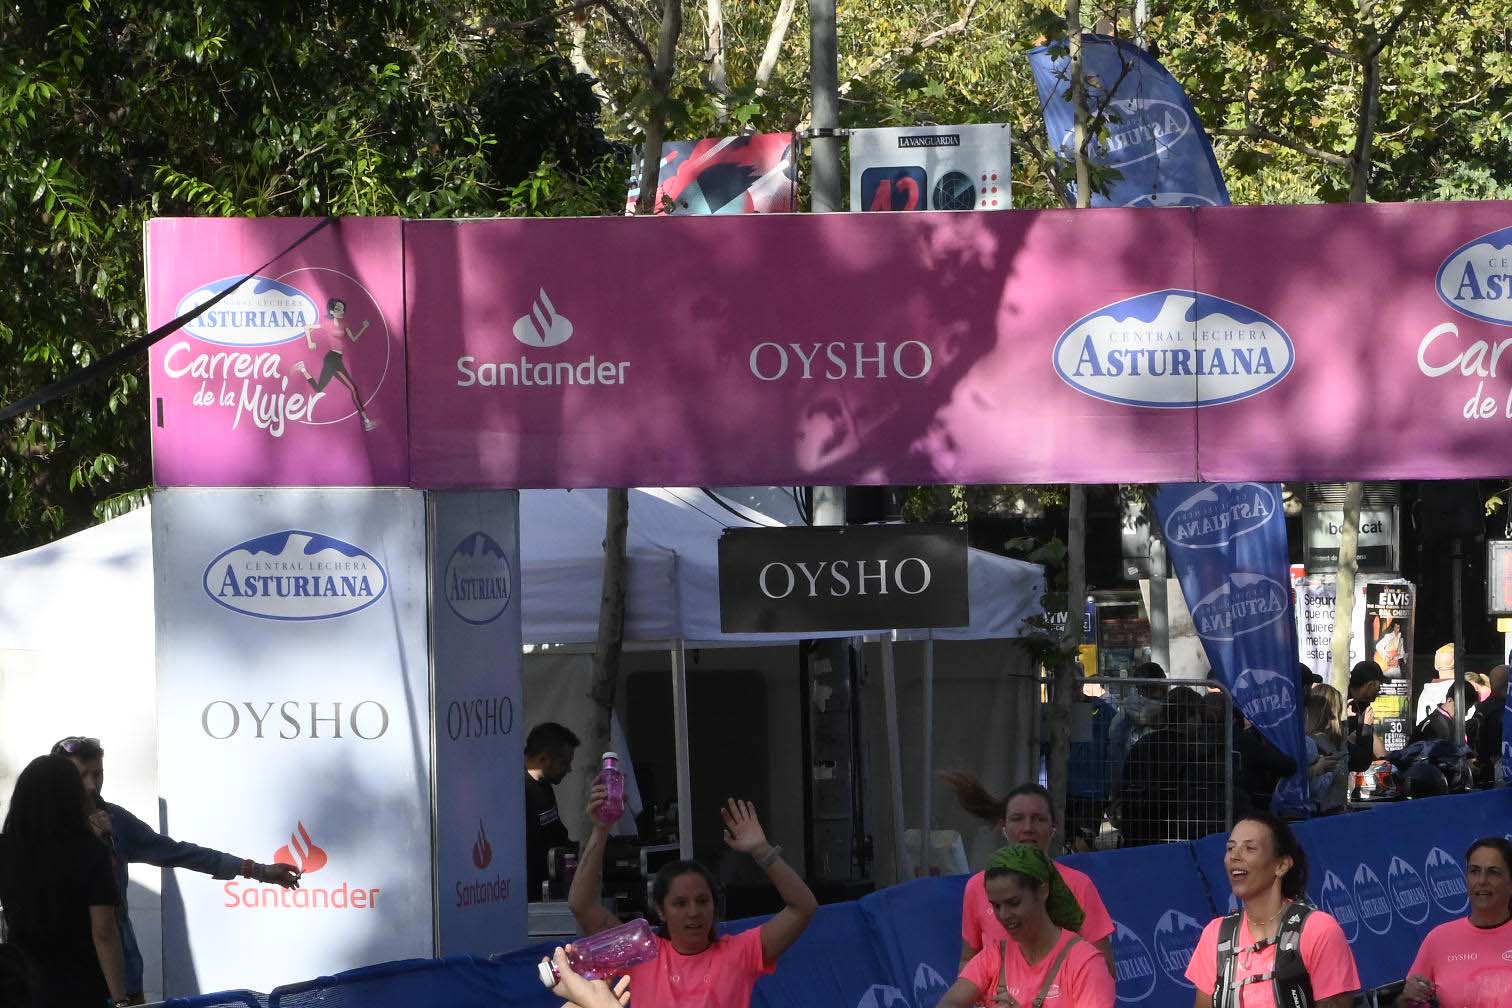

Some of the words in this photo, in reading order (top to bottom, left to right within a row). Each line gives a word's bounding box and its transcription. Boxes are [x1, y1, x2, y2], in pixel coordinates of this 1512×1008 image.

[1109, 329, 1184, 343] CENTRAL
[1192, 329, 1268, 342] LECHERA
[164, 341, 282, 379] Carrera
[457, 355, 631, 387] Santander
[749, 340, 934, 382] OYSHO
[1072, 335, 1276, 377] ASTURIANA
[192, 380, 215, 407] de
[219, 380, 236, 407] la
[232, 375, 327, 437] Mujer
[1463, 382, 1497, 419] de
[218, 564, 374, 598] ASTURIANA
[245, 561, 302, 571] CENTRAL
[308, 561, 368, 571] LECHERA
[759, 557, 932, 599] OYSHO
[450, 567, 508, 601] ASTURIANA
[1379, 592, 1411, 605] ELVIS
[1305, 623, 1335, 637] quiere
[201, 700, 390, 740] OYSHO
[447, 696, 513, 742] OYSHO
[224, 881, 382, 909] Santander
[455, 876, 512, 908] Santander
[1447, 953, 1478, 962] OYSHO
